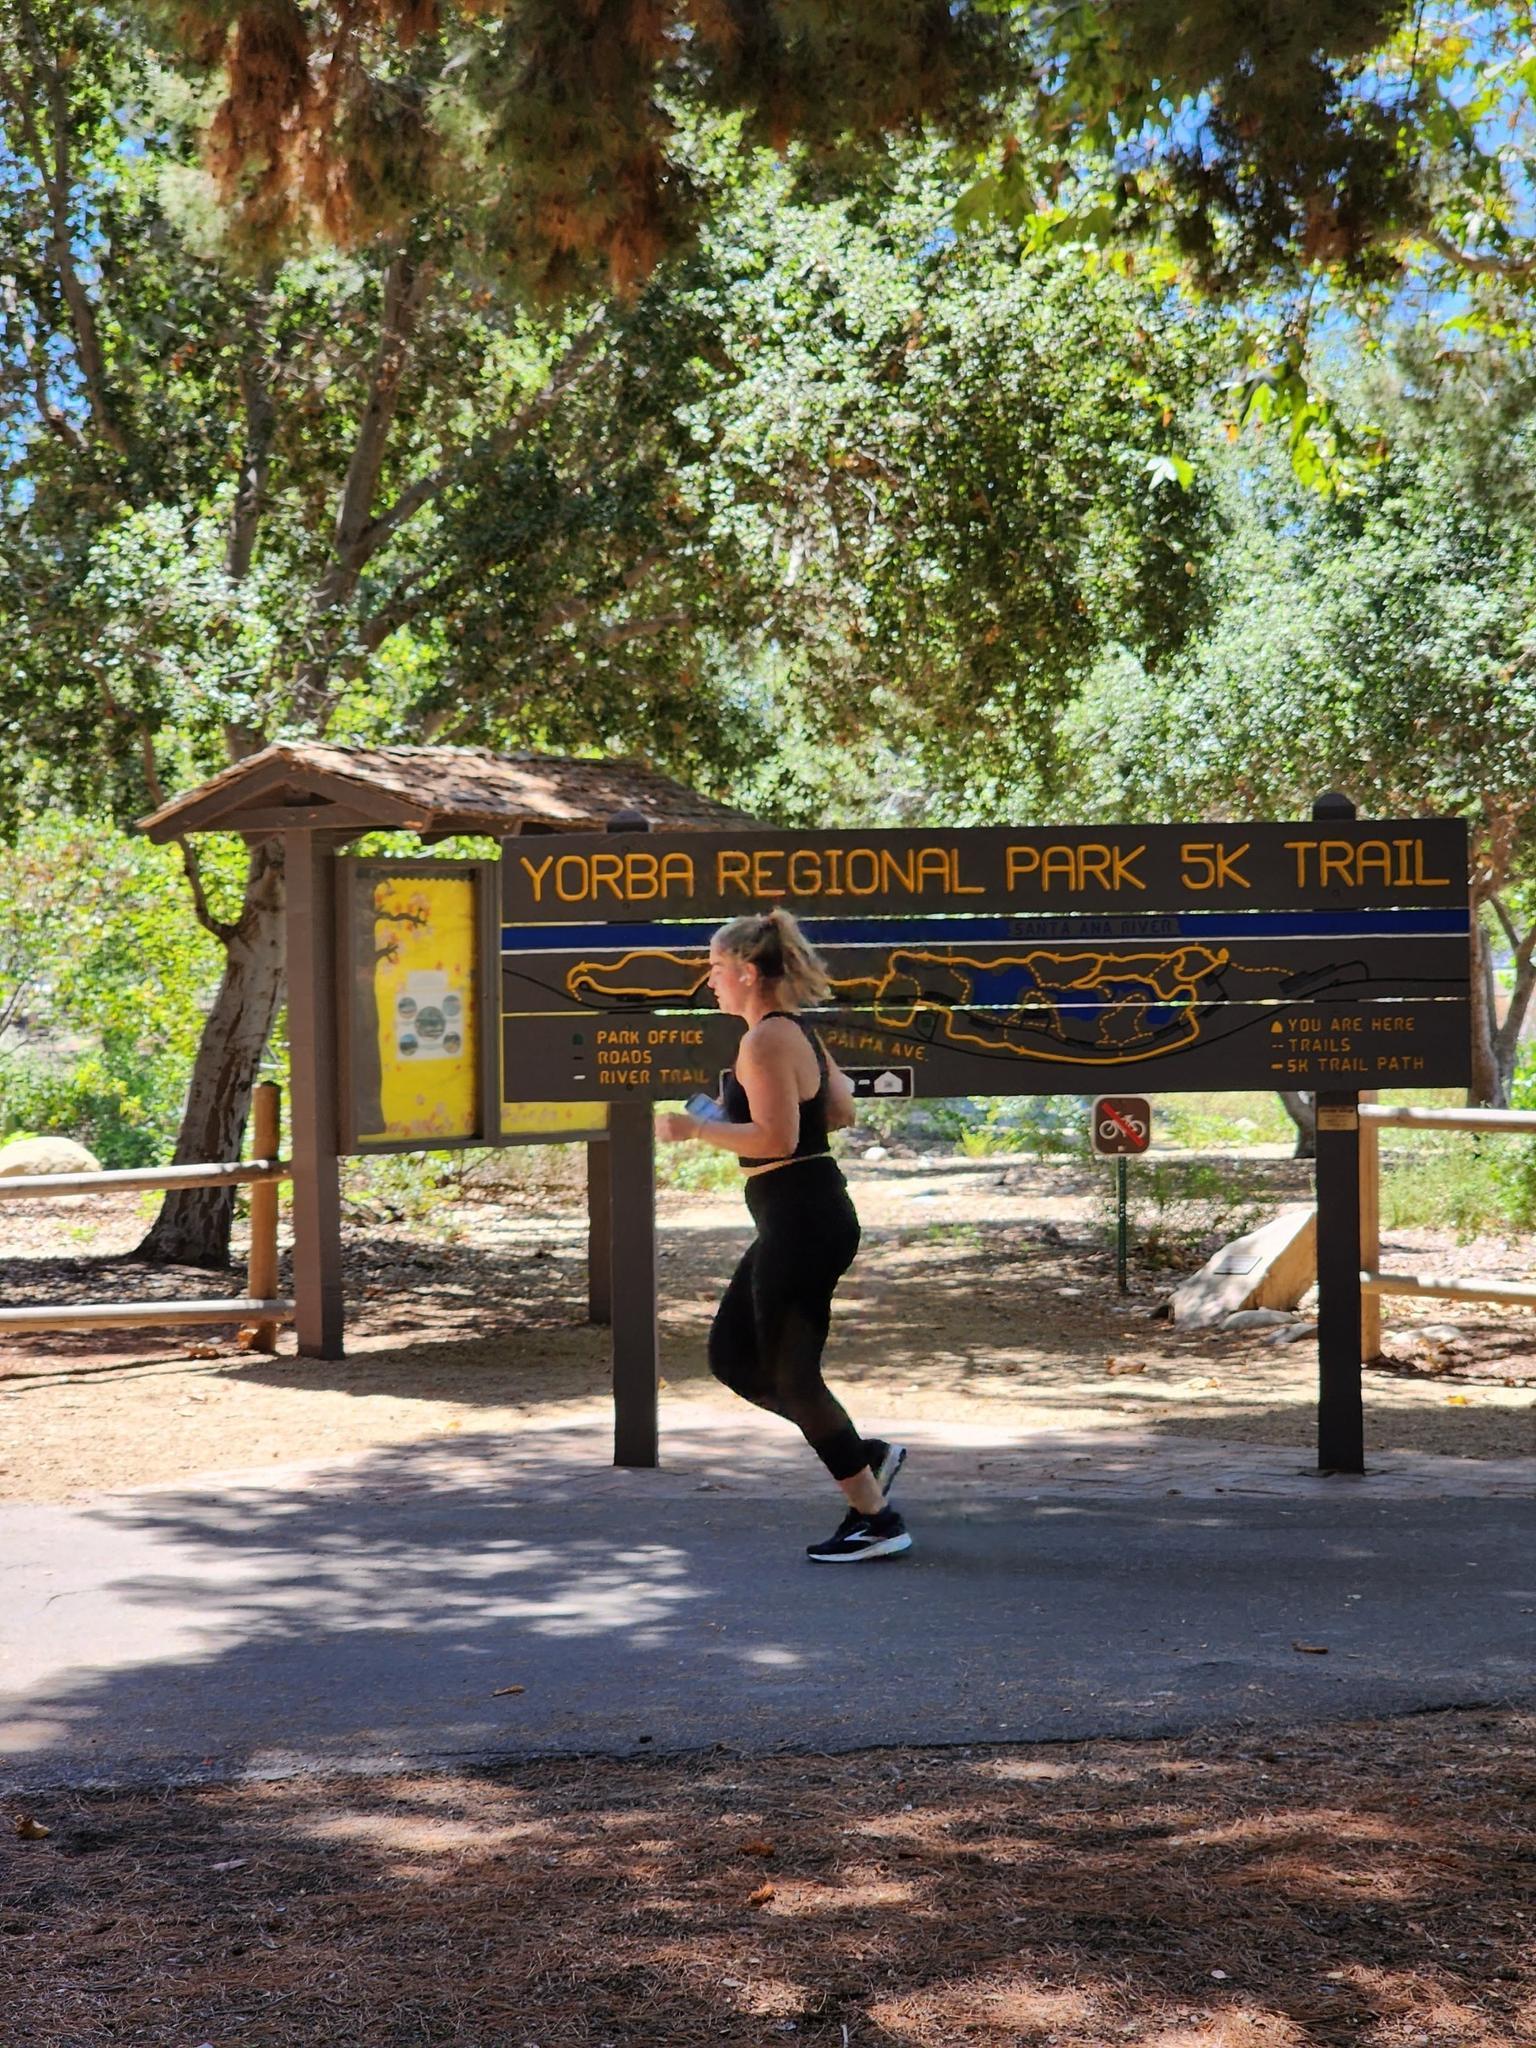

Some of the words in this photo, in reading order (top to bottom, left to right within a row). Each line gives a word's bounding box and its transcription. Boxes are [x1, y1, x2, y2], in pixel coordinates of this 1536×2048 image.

[520, 852, 695, 902] YORBA
[717, 847, 986, 898] REGIONAL
[1005, 843, 1147, 892] PARK
[1180, 842, 1252, 891] 5K
[1284, 838, 1450, 888] TRAIL
[1013, 919, 1071, 937] SANTA
[1079, 920, 1113, 936] ANA
[1120, 918, 1173, 936] RIVER
[1287, 1017, 1322, 1033] YOU
[1330, 1016, 1363, 1032] ARE
[1371, 1016, 1416, 1032] HERE
[596, 1029, 640, 1045] PARK
[647, 1029, 704, 1045] OFFICE
[1288, 1037, 1352, 1053] TRAILS
[597, 1049, 653, 1065] ROADS
[891, 1041, 930, 1063] AVE.
[1286, 1058, 1309, 1073] 5K
[1317, 1056, 1369, 1073] TRAIL
[1376, 1055, 1425, 1071] PATH
[599, 1069, 651, 1084] RIVER
[659, 1068, 710, 1084] TRAIL
